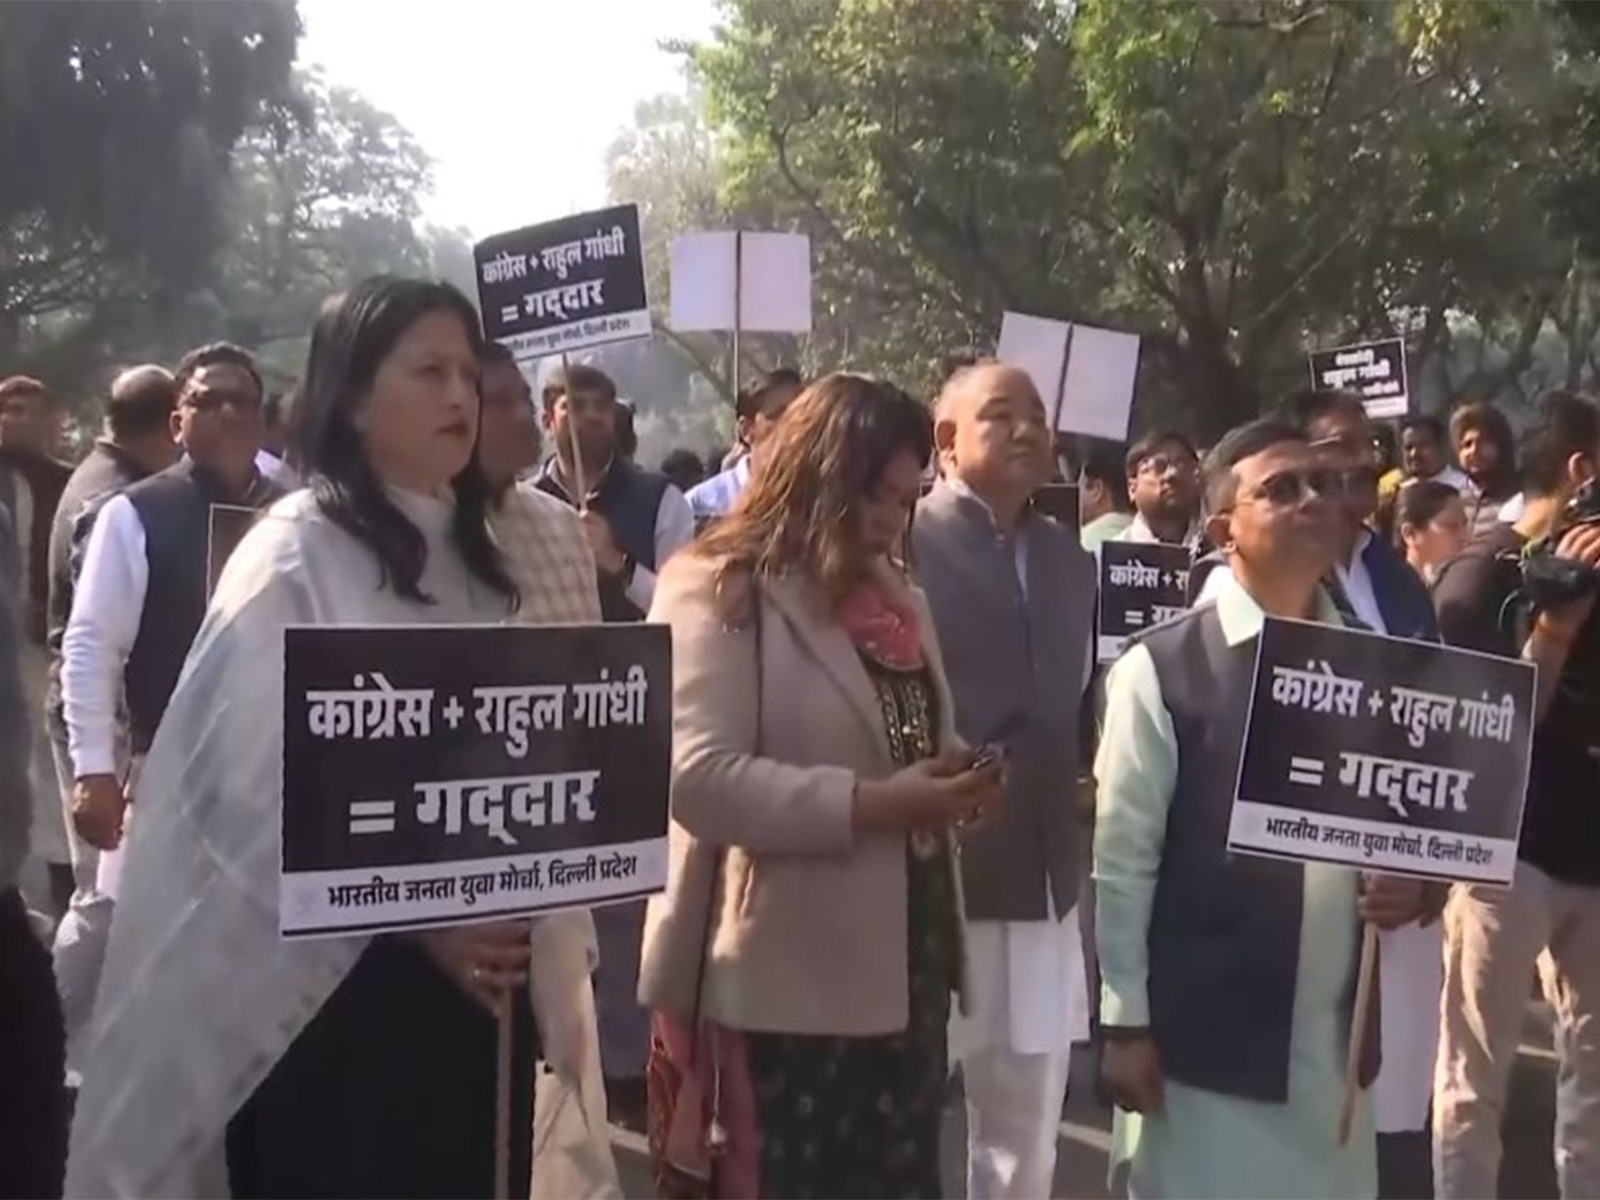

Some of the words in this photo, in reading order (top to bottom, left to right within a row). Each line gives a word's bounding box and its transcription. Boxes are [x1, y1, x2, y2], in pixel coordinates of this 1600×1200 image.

[482, 251, 527, 284] कांग्रेस
[541, 240, 582, 279] राहुल
[584, 225, 625, 259] गांधी
[501, 304, 519, 323] =
[523, 278, 605, 320] गद्दार
[1109, 559, 1160, 588] कांग्रेस
[1162, 572, 1172, 586] +
[1125, 610, 1144, 625] =
[306, 672, 434, 740] कांग्रेस
[442, 696, 464, 730] +
[473, 684, 567, 759] राहुल
[573, 664, 648, 728] गांधी
[1272, 659, 1363, 718] कांग्रेस
[1368, 690, 1384, 717] +
[1390, 686, 1455, 748] राहुल
[1459, 691, 1515, 743] गांधी
[349, 800, 395, 835] =
[413, 769, 601, 846] गद्दार
[1289, 756, 1325, 786] =
[1338, 751, 1475, 817] गद्दार
[1266, 816, 1319, 843] भारतीय
[1322, 824, 1360, 847] जनता
[1362, 834, 1389, 858] युवा
[1391, 833, 1424, 860] मोर्चा,
[1426, 836, 1463, 862] दिल्ली
[1465, 843, 1494, 866] प्रदेश
[328, 876, 400, 908] भारतीय
[404, 876, 456, 903] जनता
[460, 872, 495, 905] युवा
[499, 862, 546, 892] मोर्चा,
[548, 857, 597, 889] दिल्ली
[600, 854, 638, 880] प्रदेश
